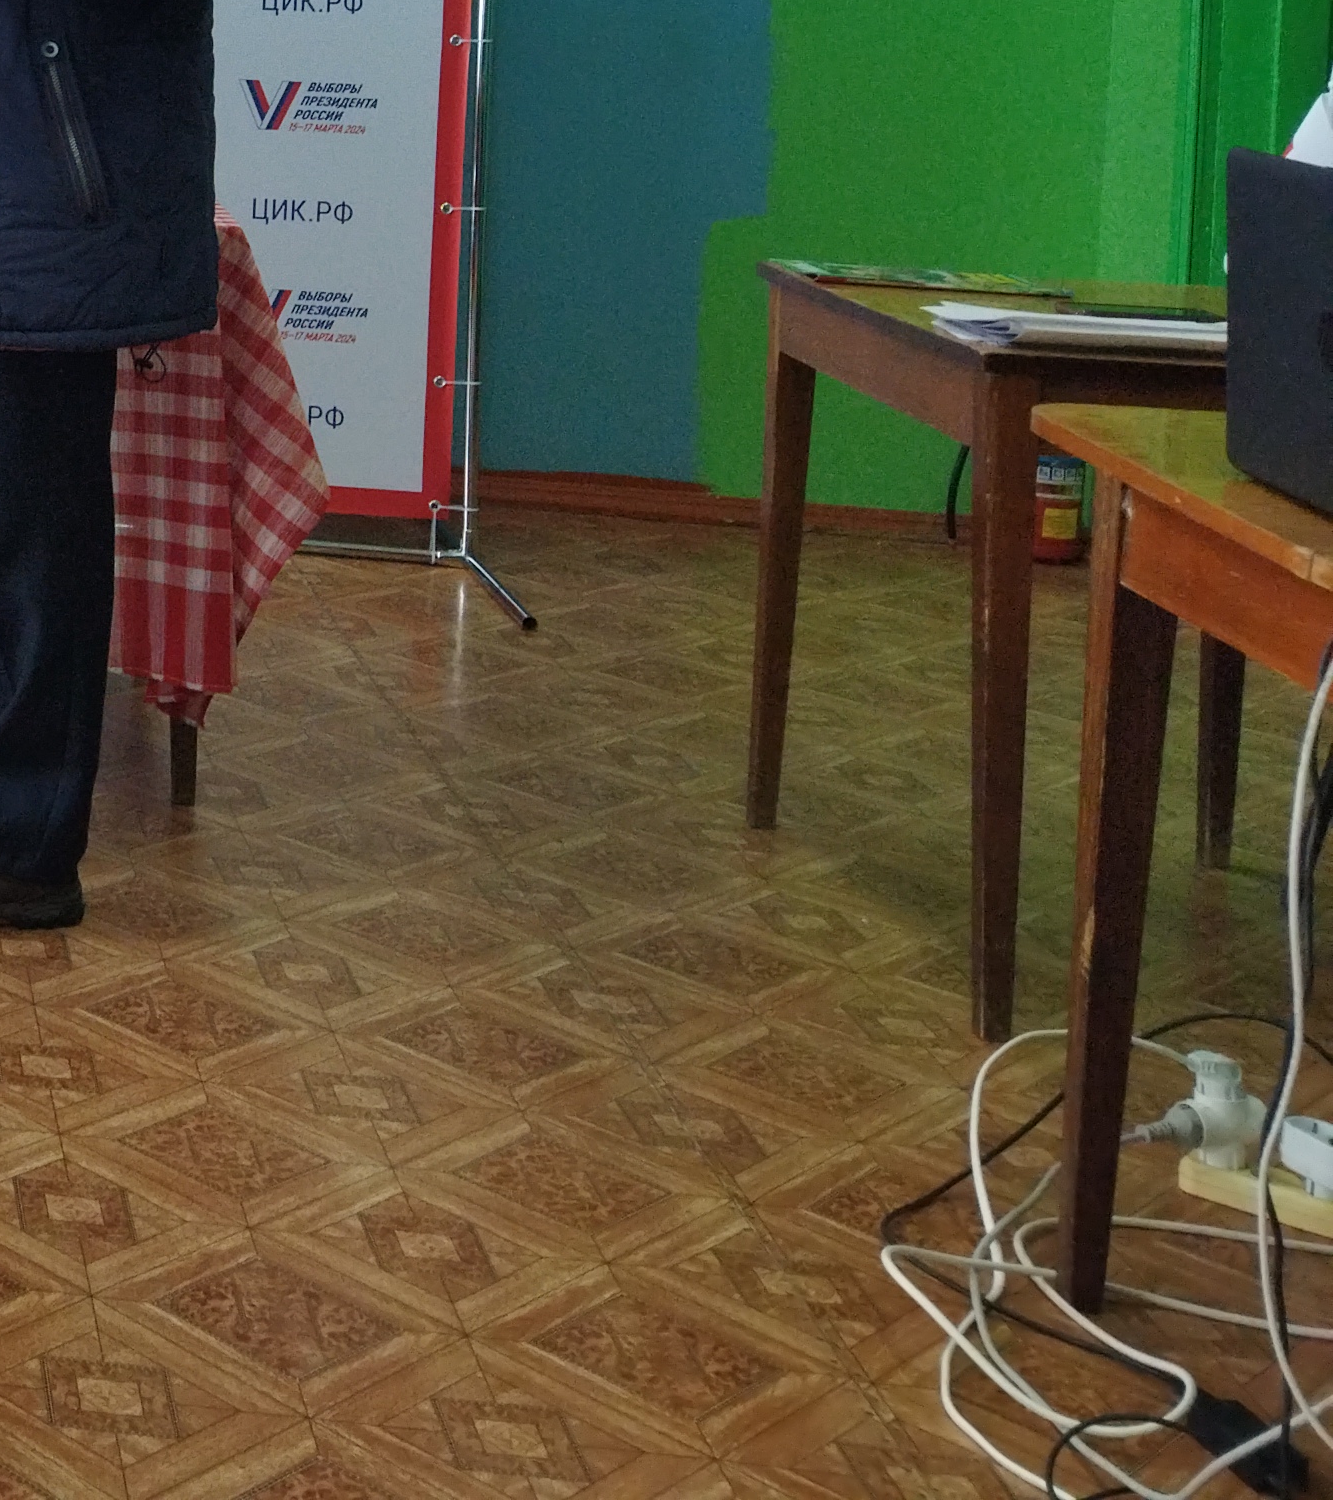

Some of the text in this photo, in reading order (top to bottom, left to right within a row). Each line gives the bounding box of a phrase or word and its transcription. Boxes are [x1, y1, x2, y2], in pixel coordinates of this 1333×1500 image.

[307, 82, 363, 95] ВЫБОРЫ
[300, 96, 378, 109] ПРЕЗИДЕНТА
[293, 109, 344, 121] РОССИИ
[313, 123, 344, 134] МАРТА
[344, 125, 366, 135] 2024
[253, 198, 353, 225] ЦИК.РФ
[298, 290, 353, 304] ВЫБОРЫ
[291, 304, 369, 319] ПРЕЗИДЕНТА
[284, 317, 334, 330] РОССИИ
[304, 332, 335, 342] МАРТА
[335, 334, 357, 344] 2024
